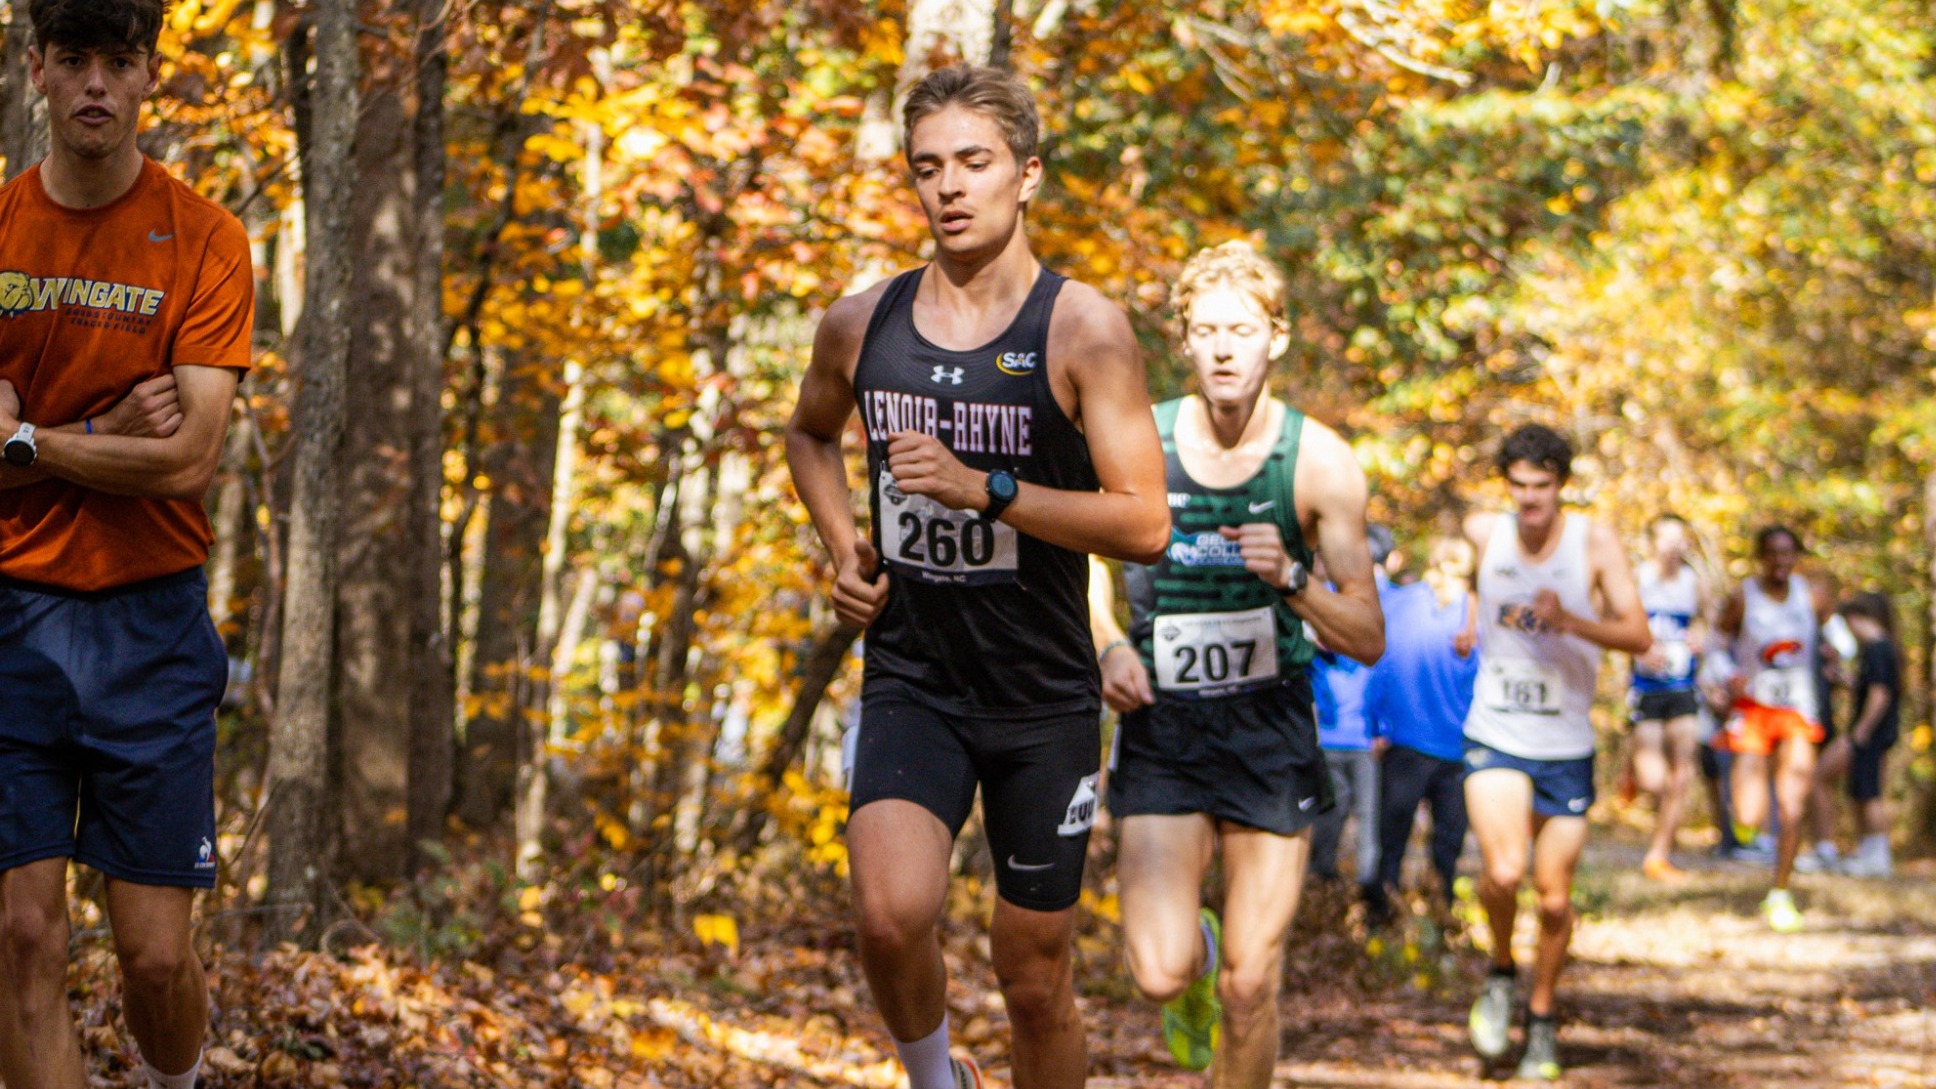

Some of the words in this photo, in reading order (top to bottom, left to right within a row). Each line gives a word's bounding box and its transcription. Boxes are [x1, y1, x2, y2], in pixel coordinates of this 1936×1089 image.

[30, 277, 165, 316] WINGATE
[1001, 351, 1038, 369] SAC
[864, 390, 1033, 456] LENOIR-RHYNE
[898, 511, 995, 567] 260
[1173, 639, 1257, 683] 207
